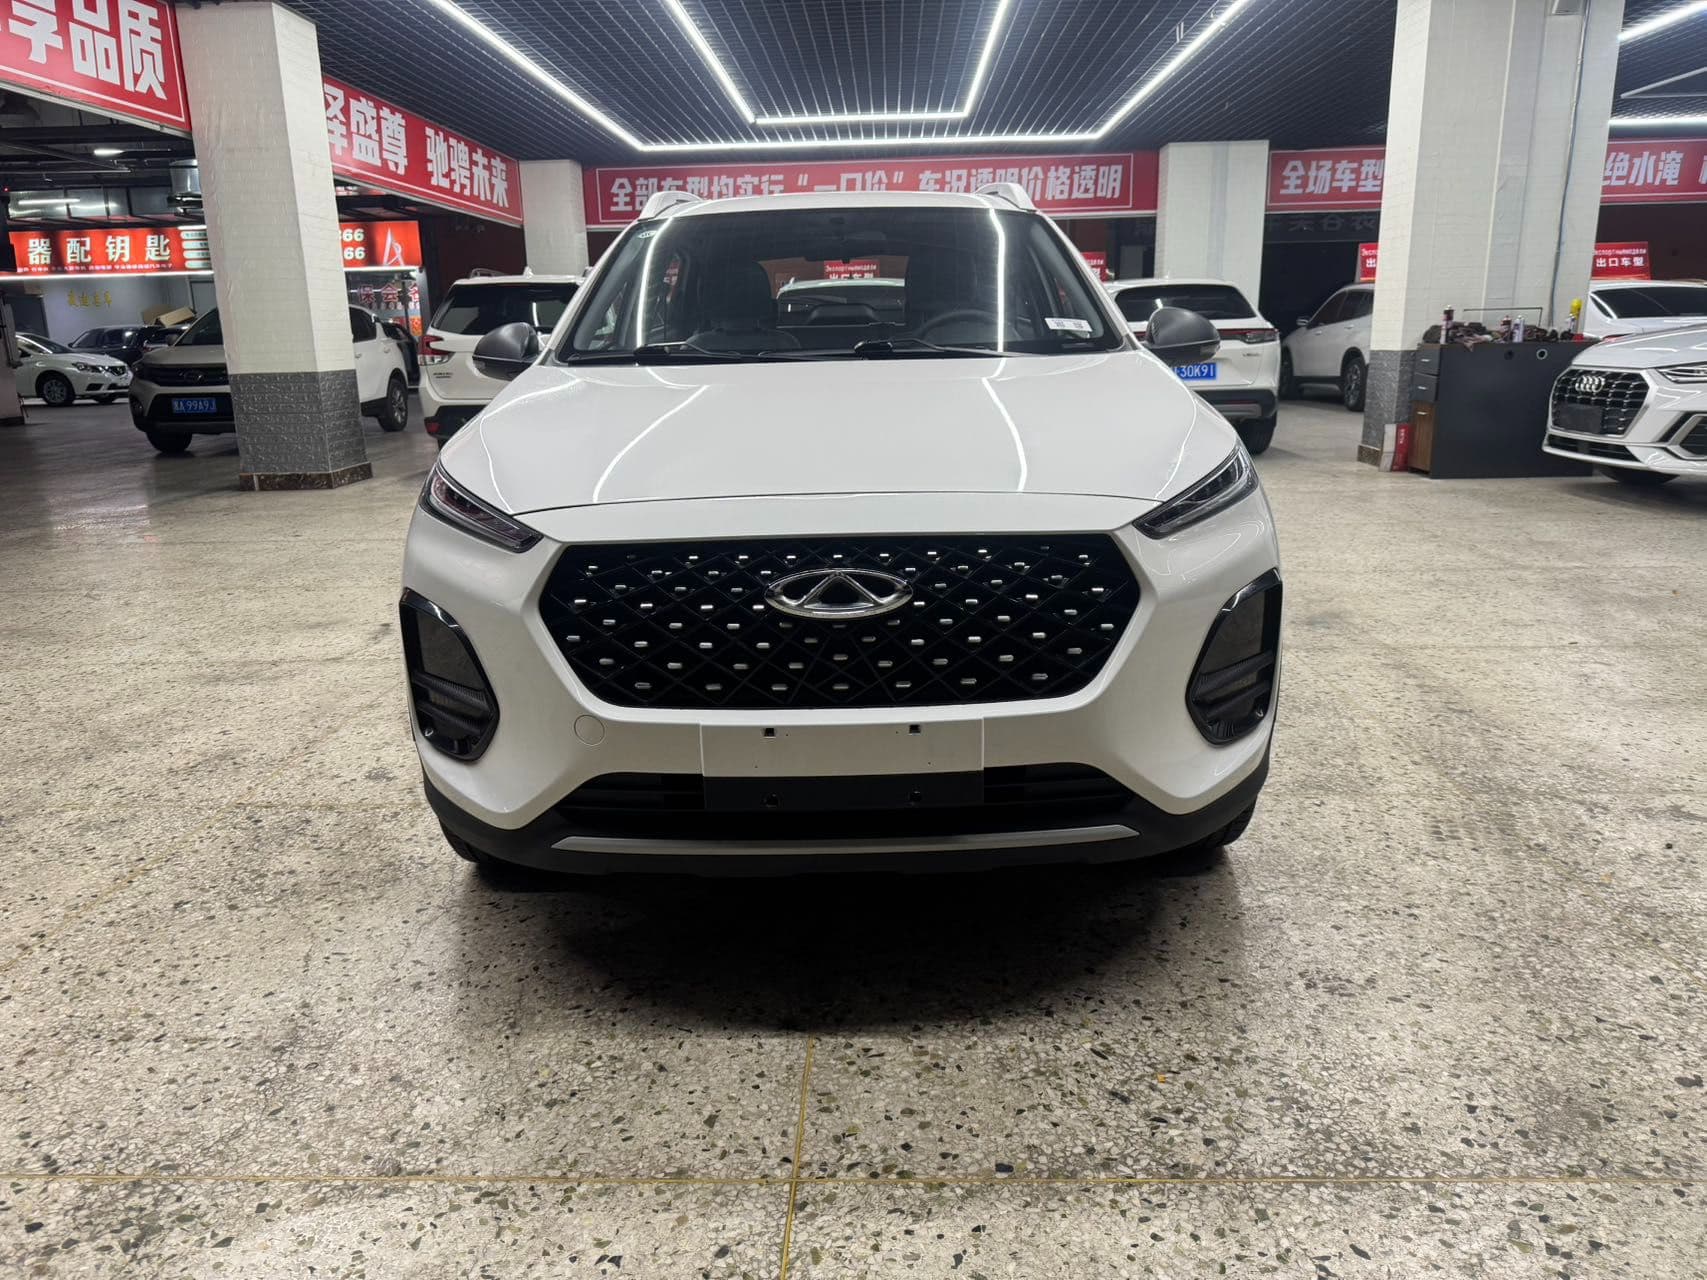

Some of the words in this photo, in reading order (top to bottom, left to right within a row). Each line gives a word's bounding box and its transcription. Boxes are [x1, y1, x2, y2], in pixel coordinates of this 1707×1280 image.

[425, 127, 509, 208] 驰骋未来
[1280, 159, 1385, 194] 全场车型
[1601, 150, 1684, 186] 绝水淹
[28, 235, 172, 265] 器配钥匙
[338, 229, 364, 241] 66
[1596, 256, 1644, 268] 出口车型
